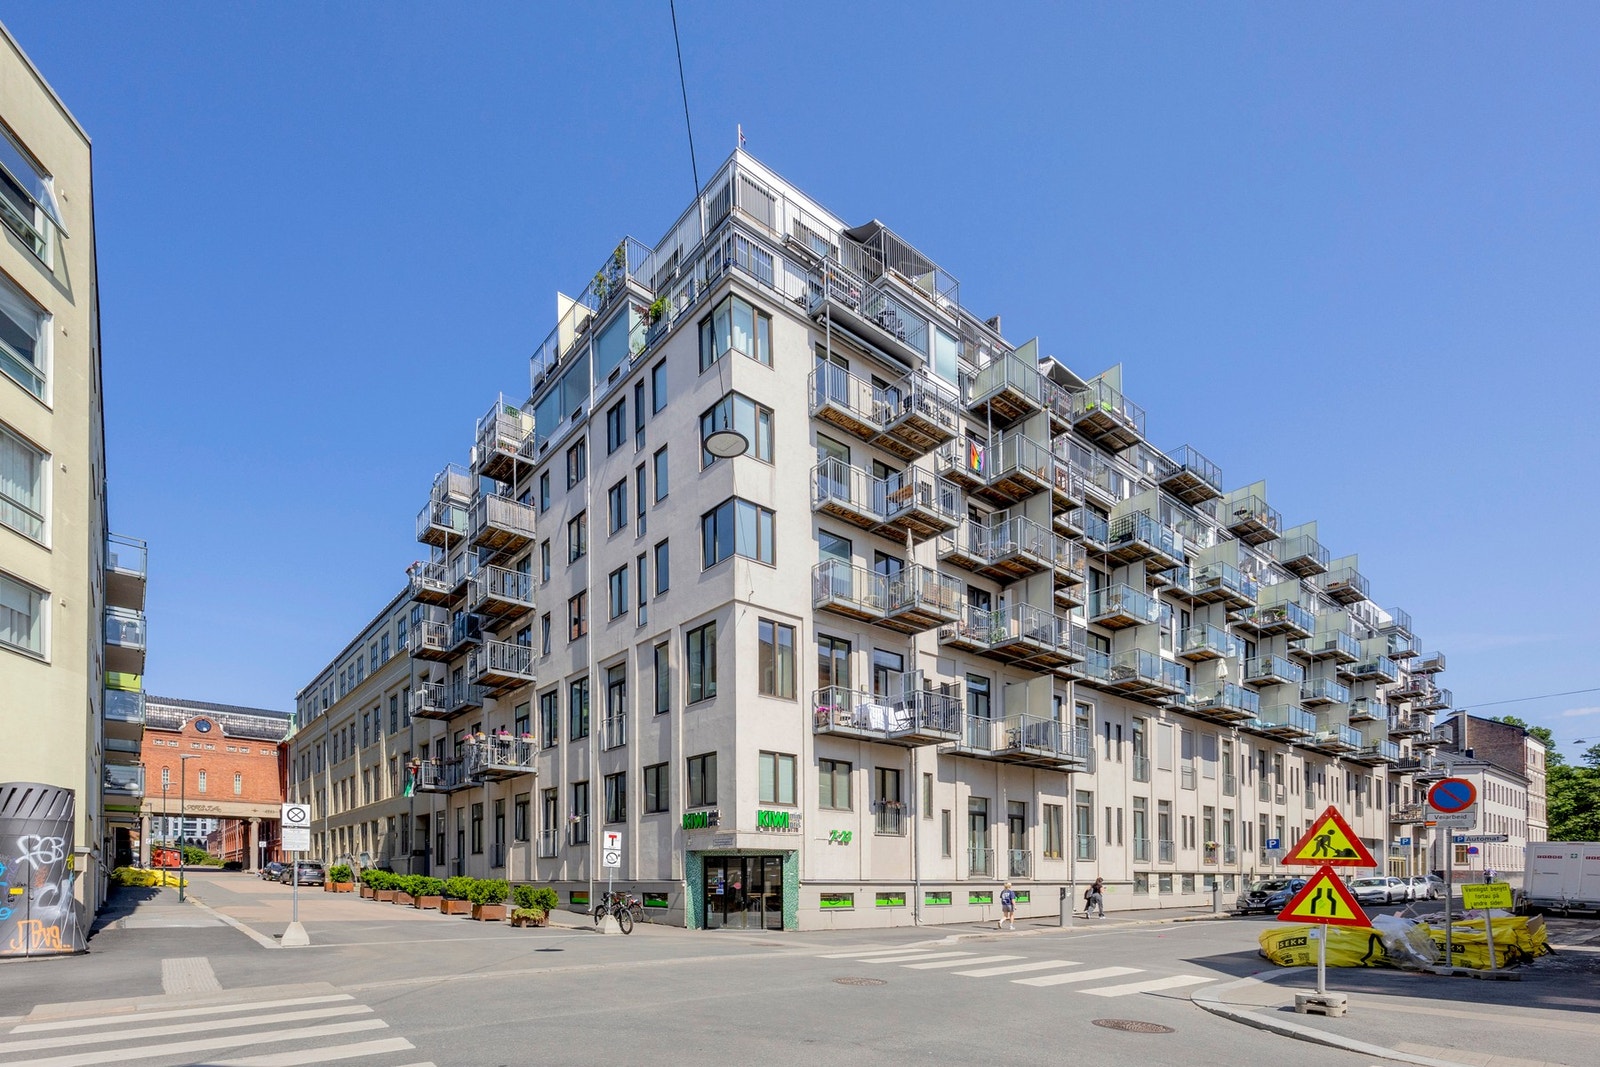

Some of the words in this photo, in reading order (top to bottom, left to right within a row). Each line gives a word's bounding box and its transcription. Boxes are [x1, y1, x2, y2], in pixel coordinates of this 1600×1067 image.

[682, 811, 708, 830] KIWI
[757, 809, 790, 829] KIWI
[1269, 840, 1277, 849] P
[1279, 938, 1305, 948] SEKK
